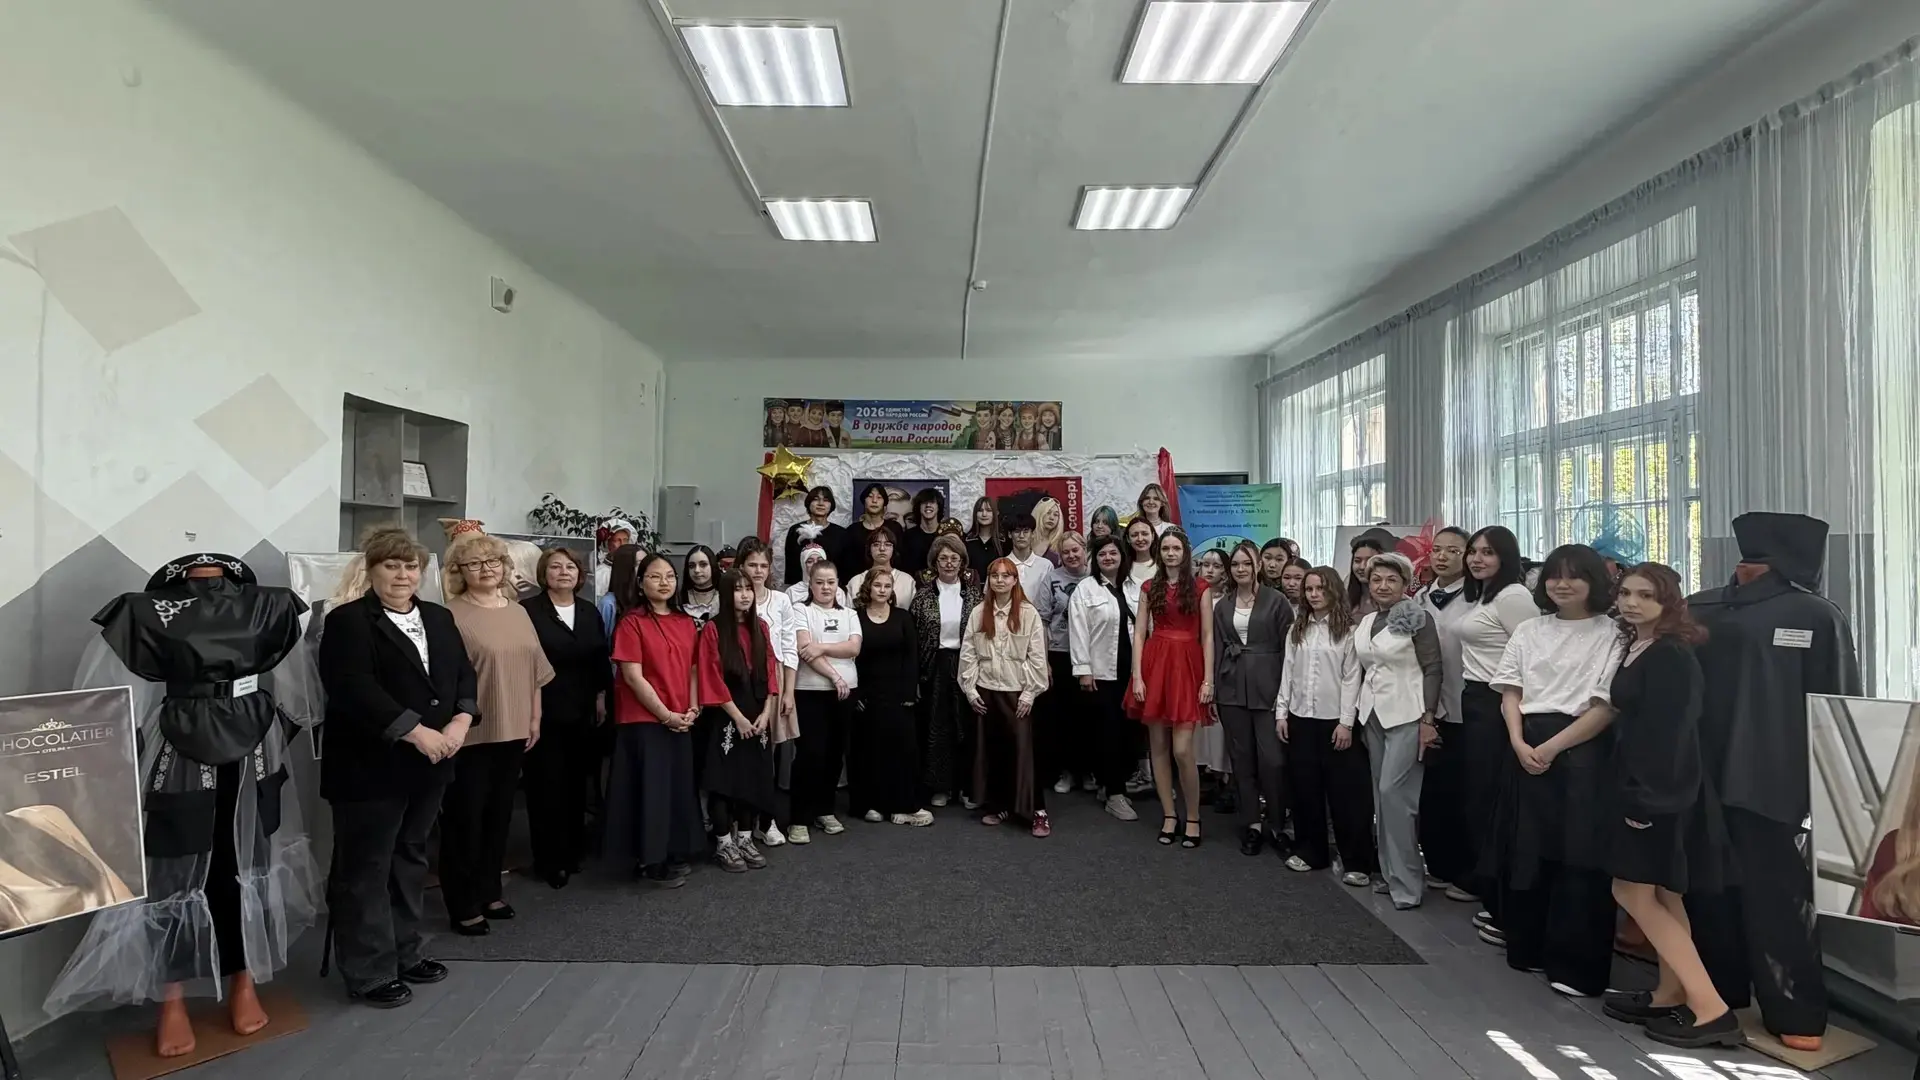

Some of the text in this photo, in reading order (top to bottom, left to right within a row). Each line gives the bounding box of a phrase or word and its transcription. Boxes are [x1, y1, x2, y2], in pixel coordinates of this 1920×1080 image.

[856, 407, 885, 417] 2026
[852, 419, 962, 434] В дружбе народов
[874, 433, 954, 444] сила России!
[1065, 480, 1079, 530] concept
[0, 727, 115, 752] HOCOLATIER
[24, 766, 88, 784] ESTEL
